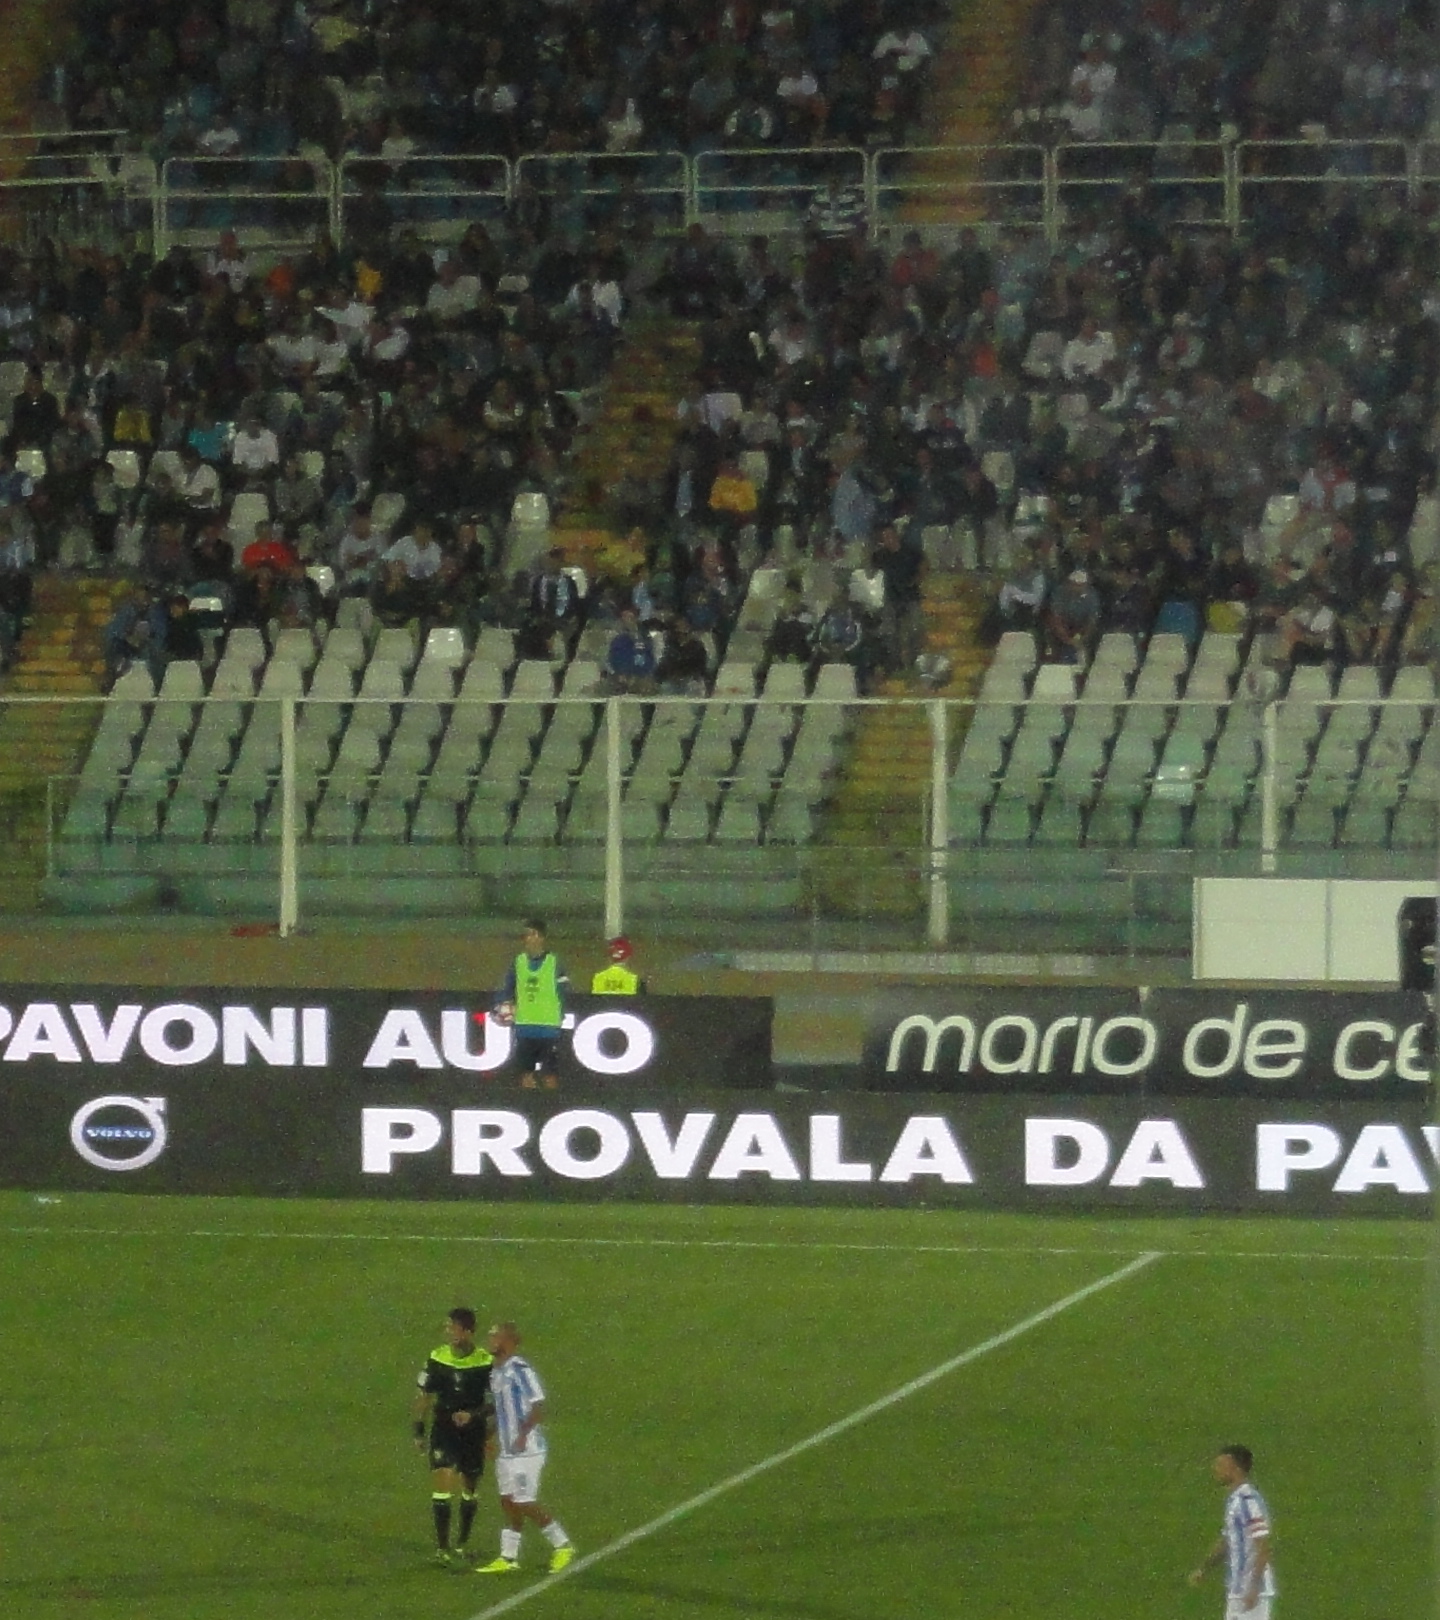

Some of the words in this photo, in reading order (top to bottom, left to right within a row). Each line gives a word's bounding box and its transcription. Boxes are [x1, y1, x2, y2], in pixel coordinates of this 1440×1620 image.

[362, 1010, 654, 1075] AUO
[886, 1015, 1157, 1077] mario
[1184, 1004, 1307, 1079] de
[362, 1108, 973, 1184] PROVALA
[1025, 1119, 1203, 1189] DA
[1257, 1124, 1440, 1194] PA
